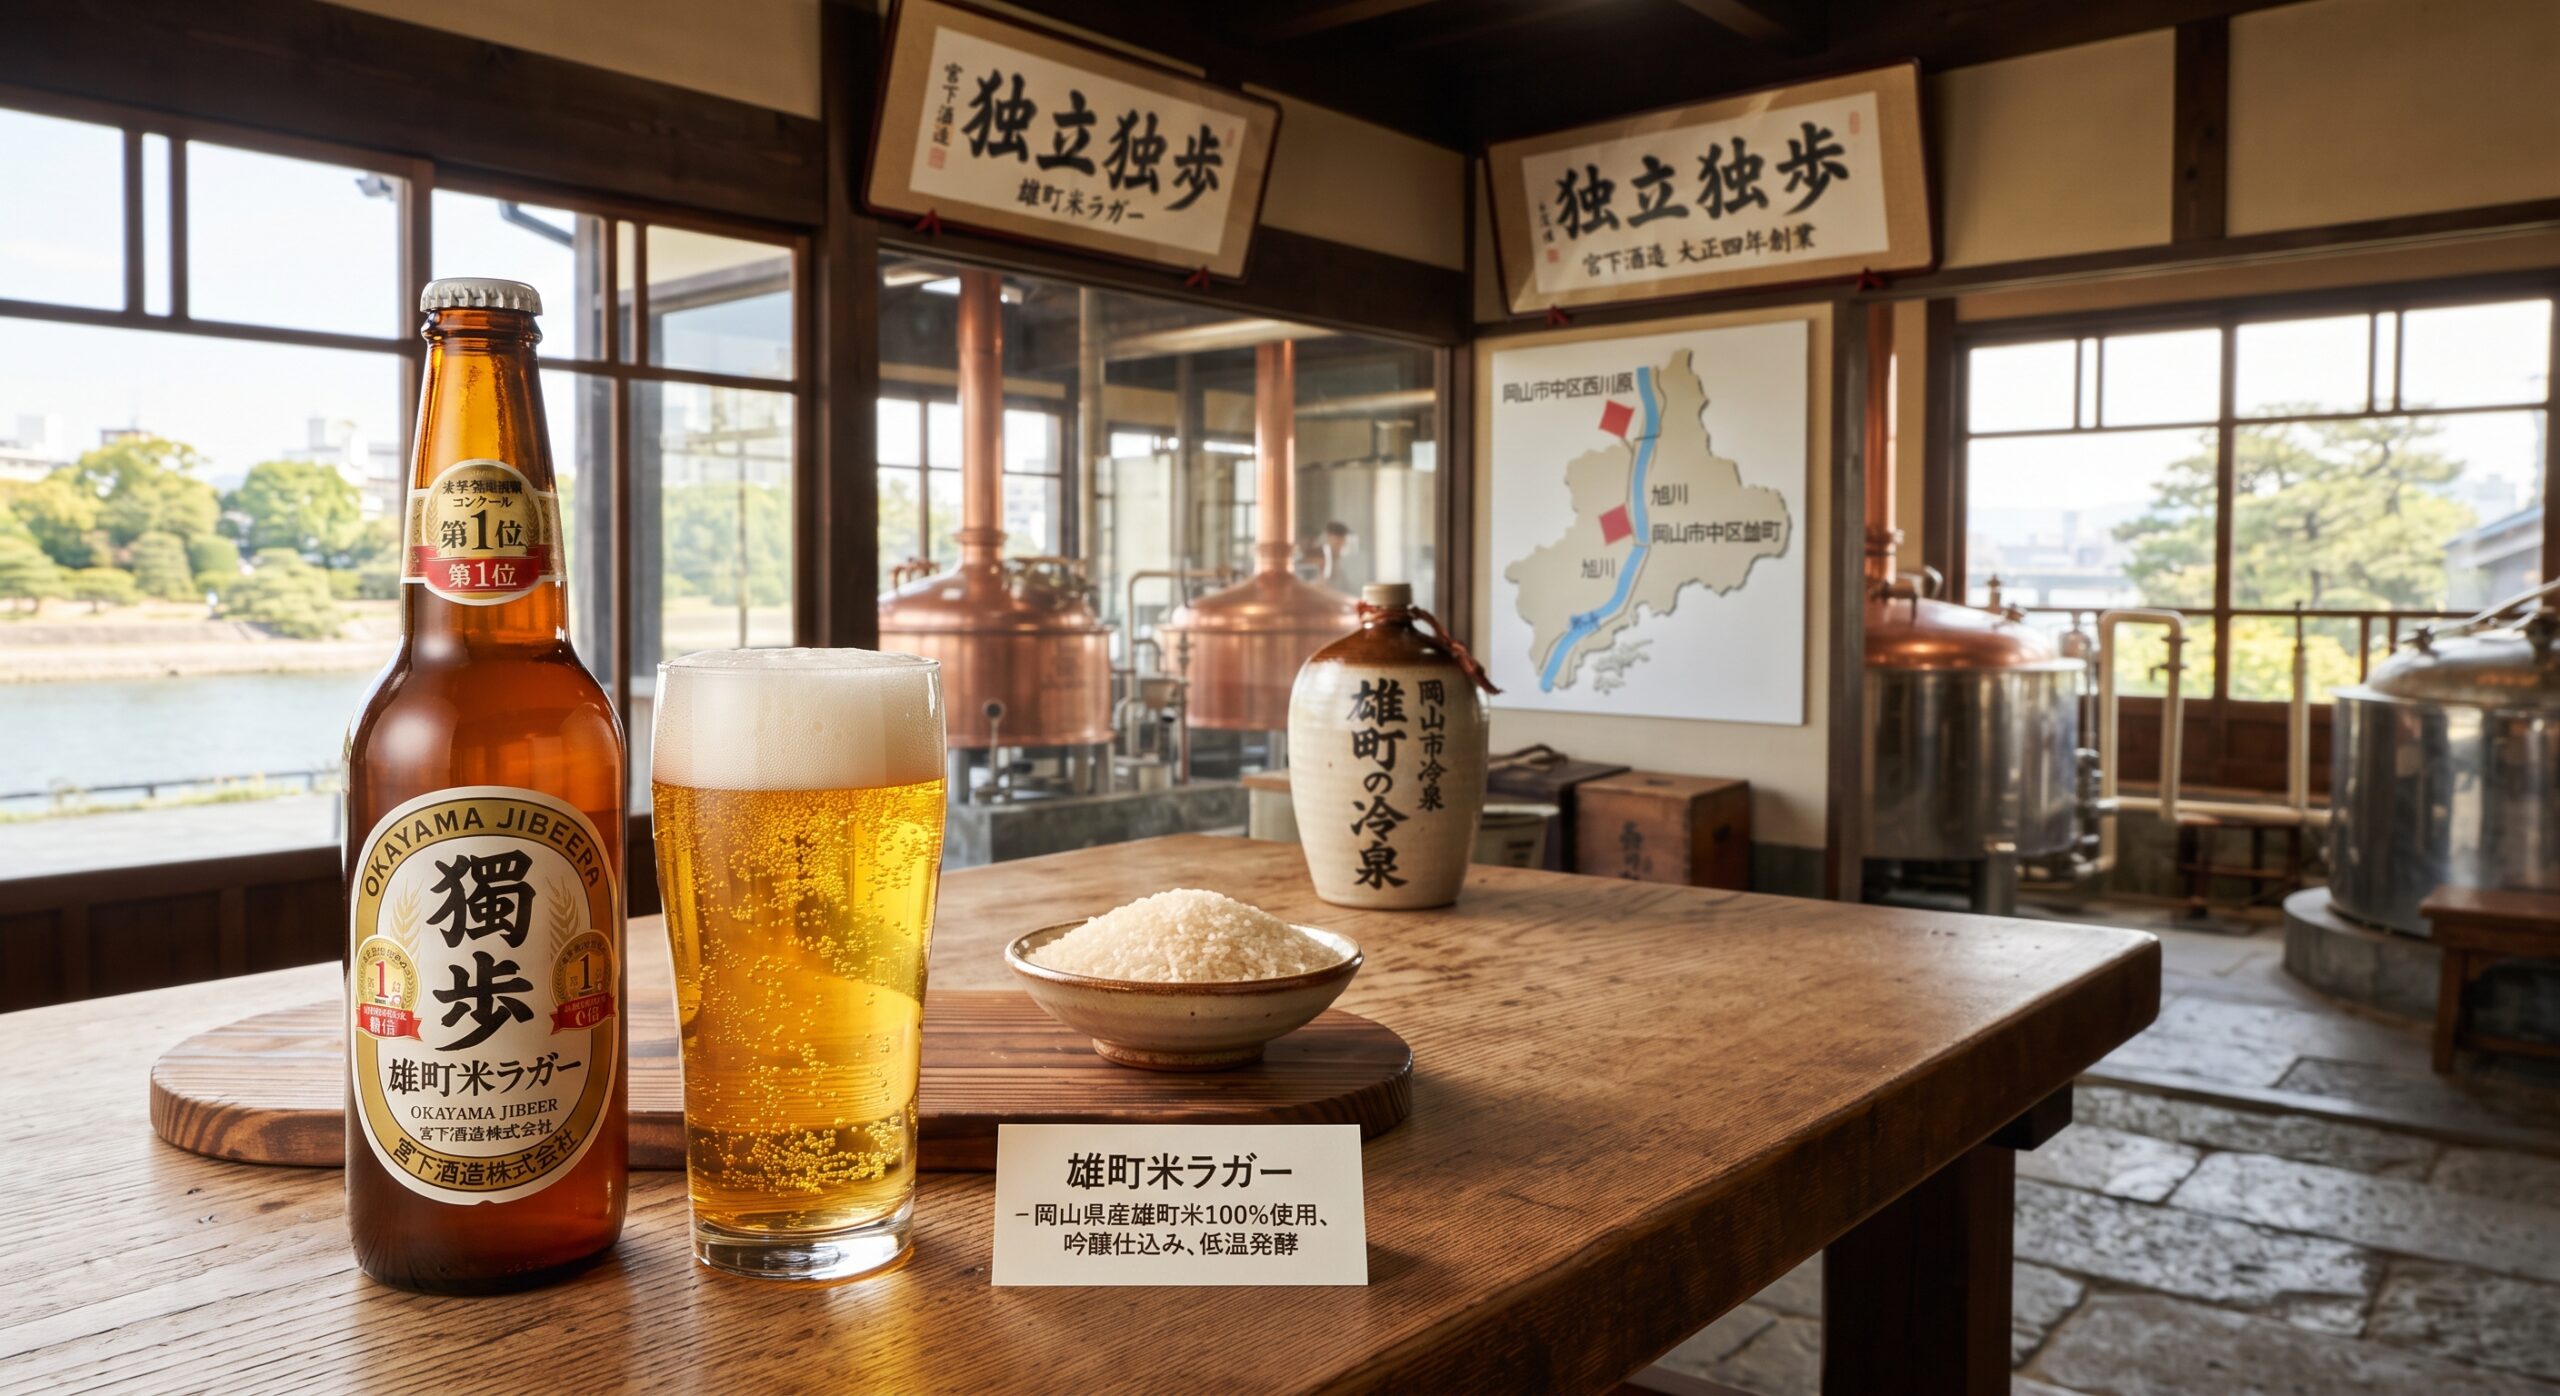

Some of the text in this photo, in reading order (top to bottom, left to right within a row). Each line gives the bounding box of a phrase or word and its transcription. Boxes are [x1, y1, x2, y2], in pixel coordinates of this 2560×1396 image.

[962, 69, 1225, 212] 独立独歩
[1555, 122, 1849, 240] 独立独歩
[1583, 223, 1816, 277] 宮下酒造 大正四年創業
[453, 495, 513, 508] コンクール
[1651, 482, 1689, 506] 旭川
[441, 509, 528, 550] 第1位
[449, 561, 517, 588] 第1位
[1581, 558, 1615, 579] 旭川
[1417, 679, 1447, 811] 岡山市冷泉
[1347, 678, 1409, 889] 雄町の冷泉
[366, 807, 484, 897] OKAYAMA
[387, 1052, 581, 1097] 雄町米ラガー
[411, 1099, 558, 1121] OKAYAMA JIBEER
[393, 1129, 579, 1186] 宮下酒造株式会社
[1067, 1152, 1293, 1190] 雄町米ラガー
